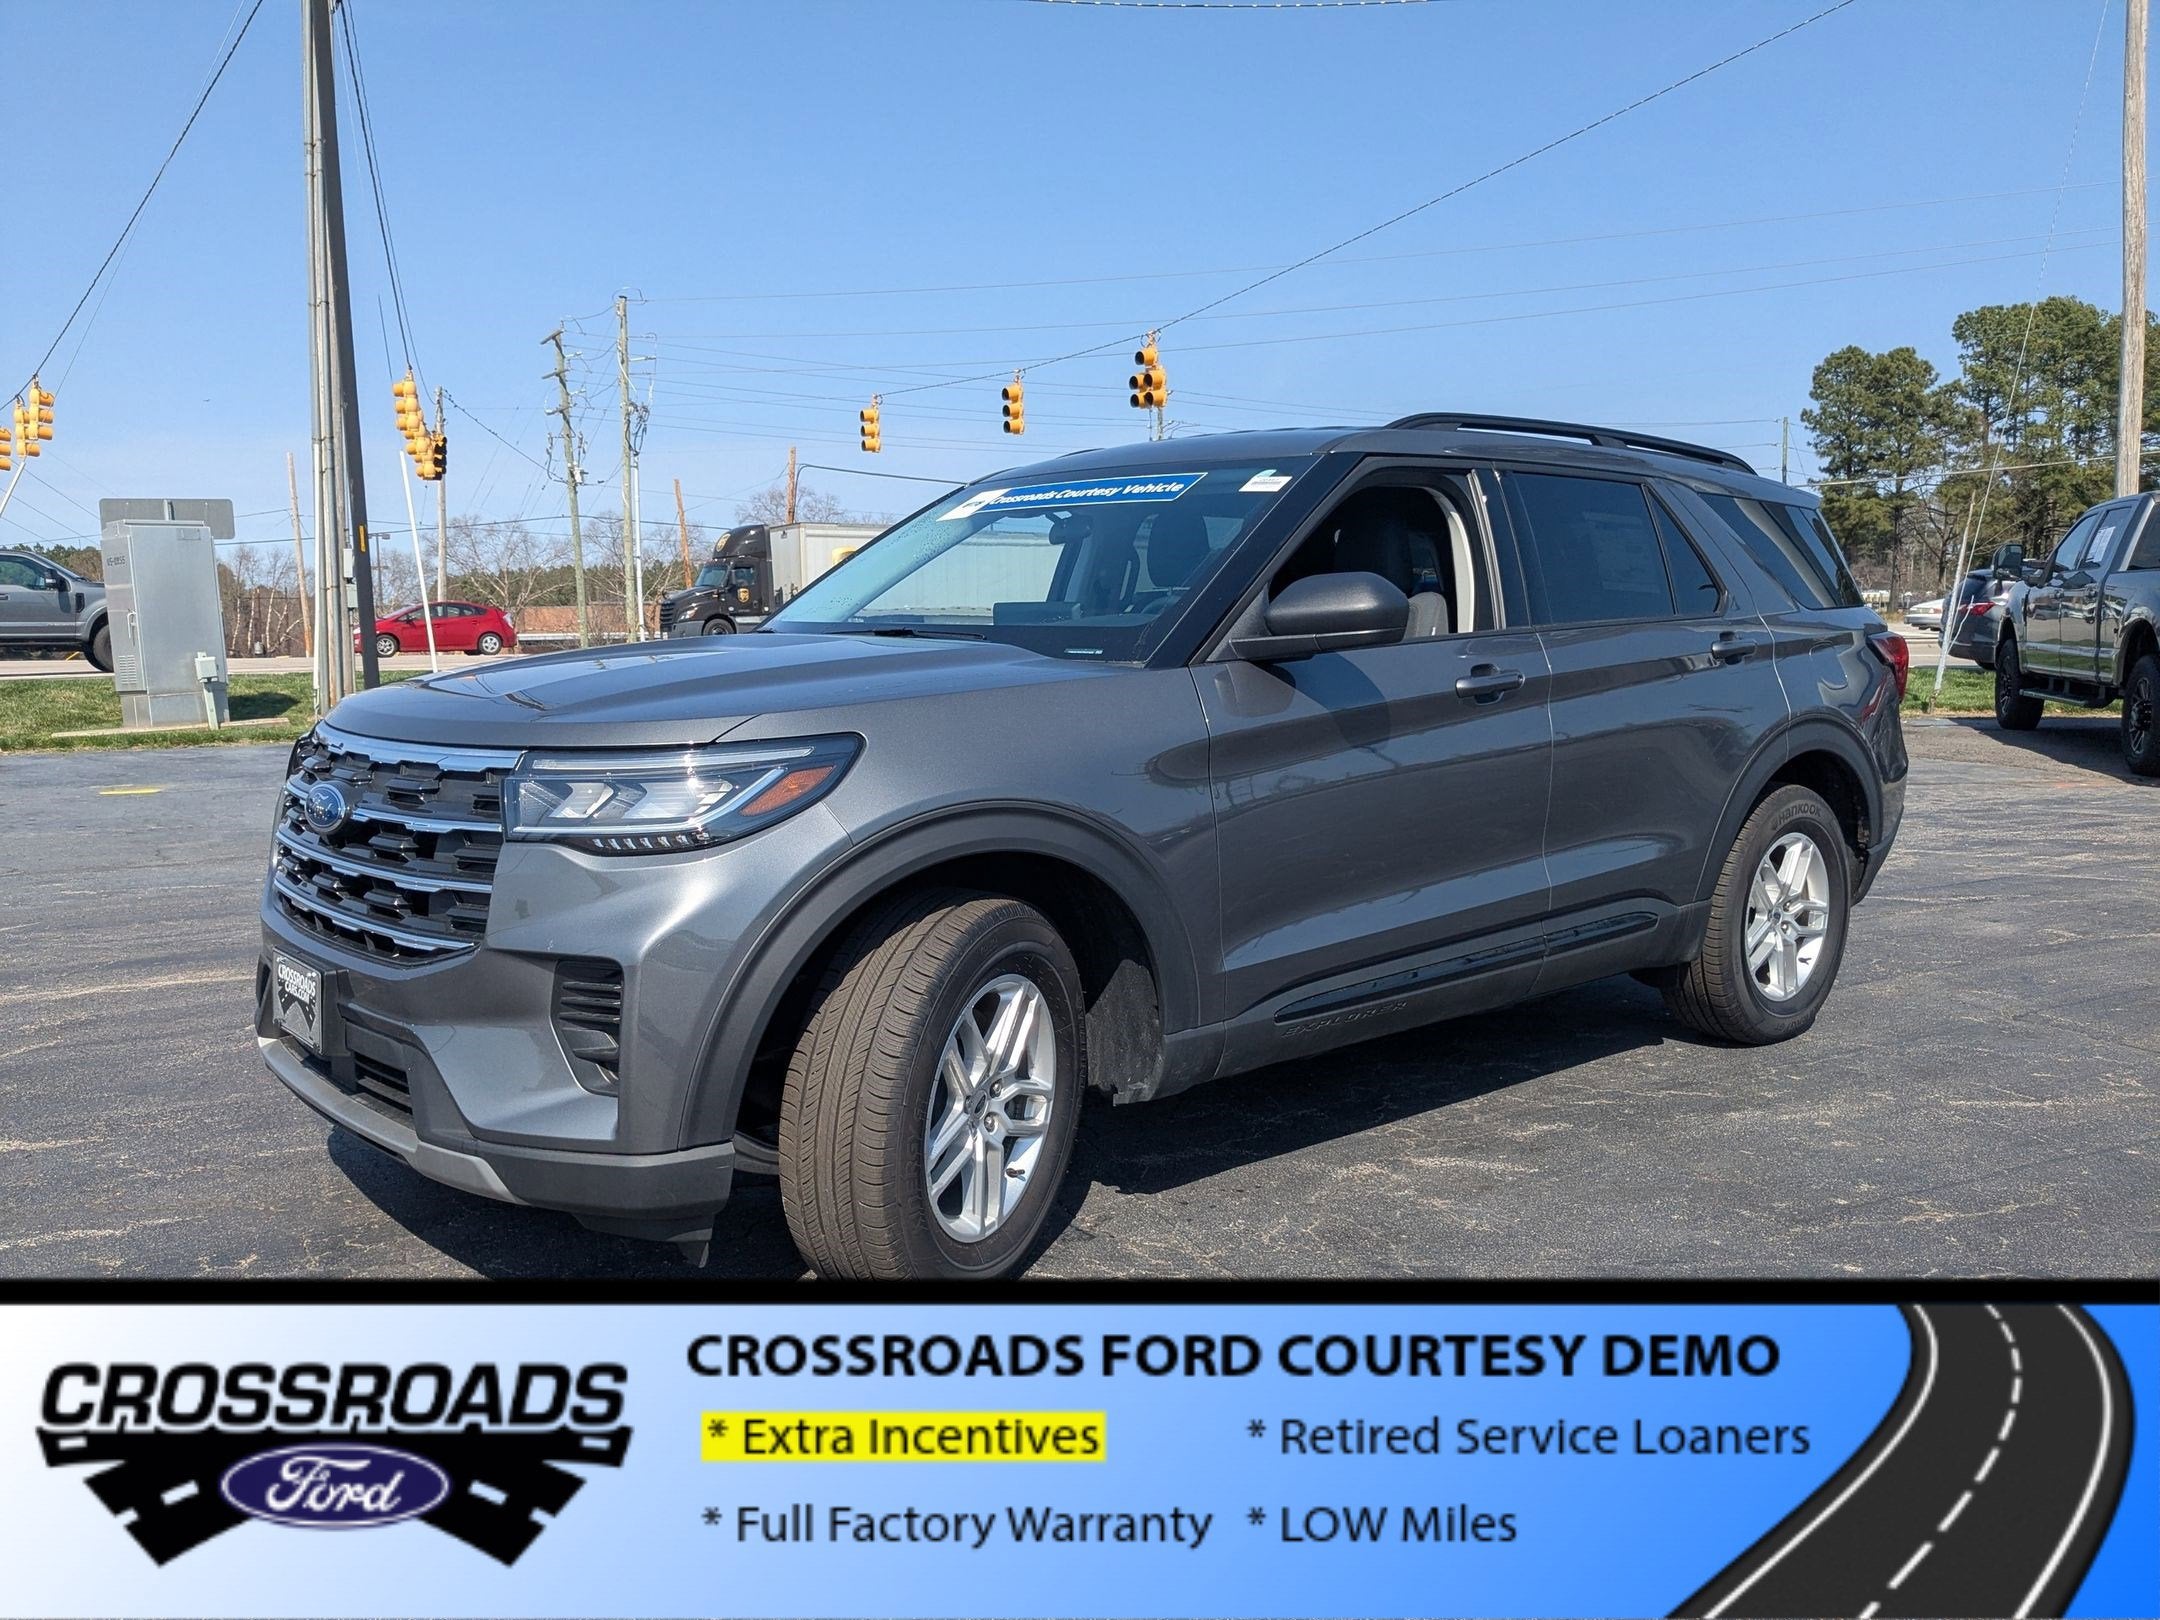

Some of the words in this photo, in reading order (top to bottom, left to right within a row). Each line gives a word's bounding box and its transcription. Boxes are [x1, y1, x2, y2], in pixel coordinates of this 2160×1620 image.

[1055, 487, 1123, 499] Courtesy
[1122, 482, 1185, 495] Vehicle
[278, 963, 316, 997] CROSSROADS
